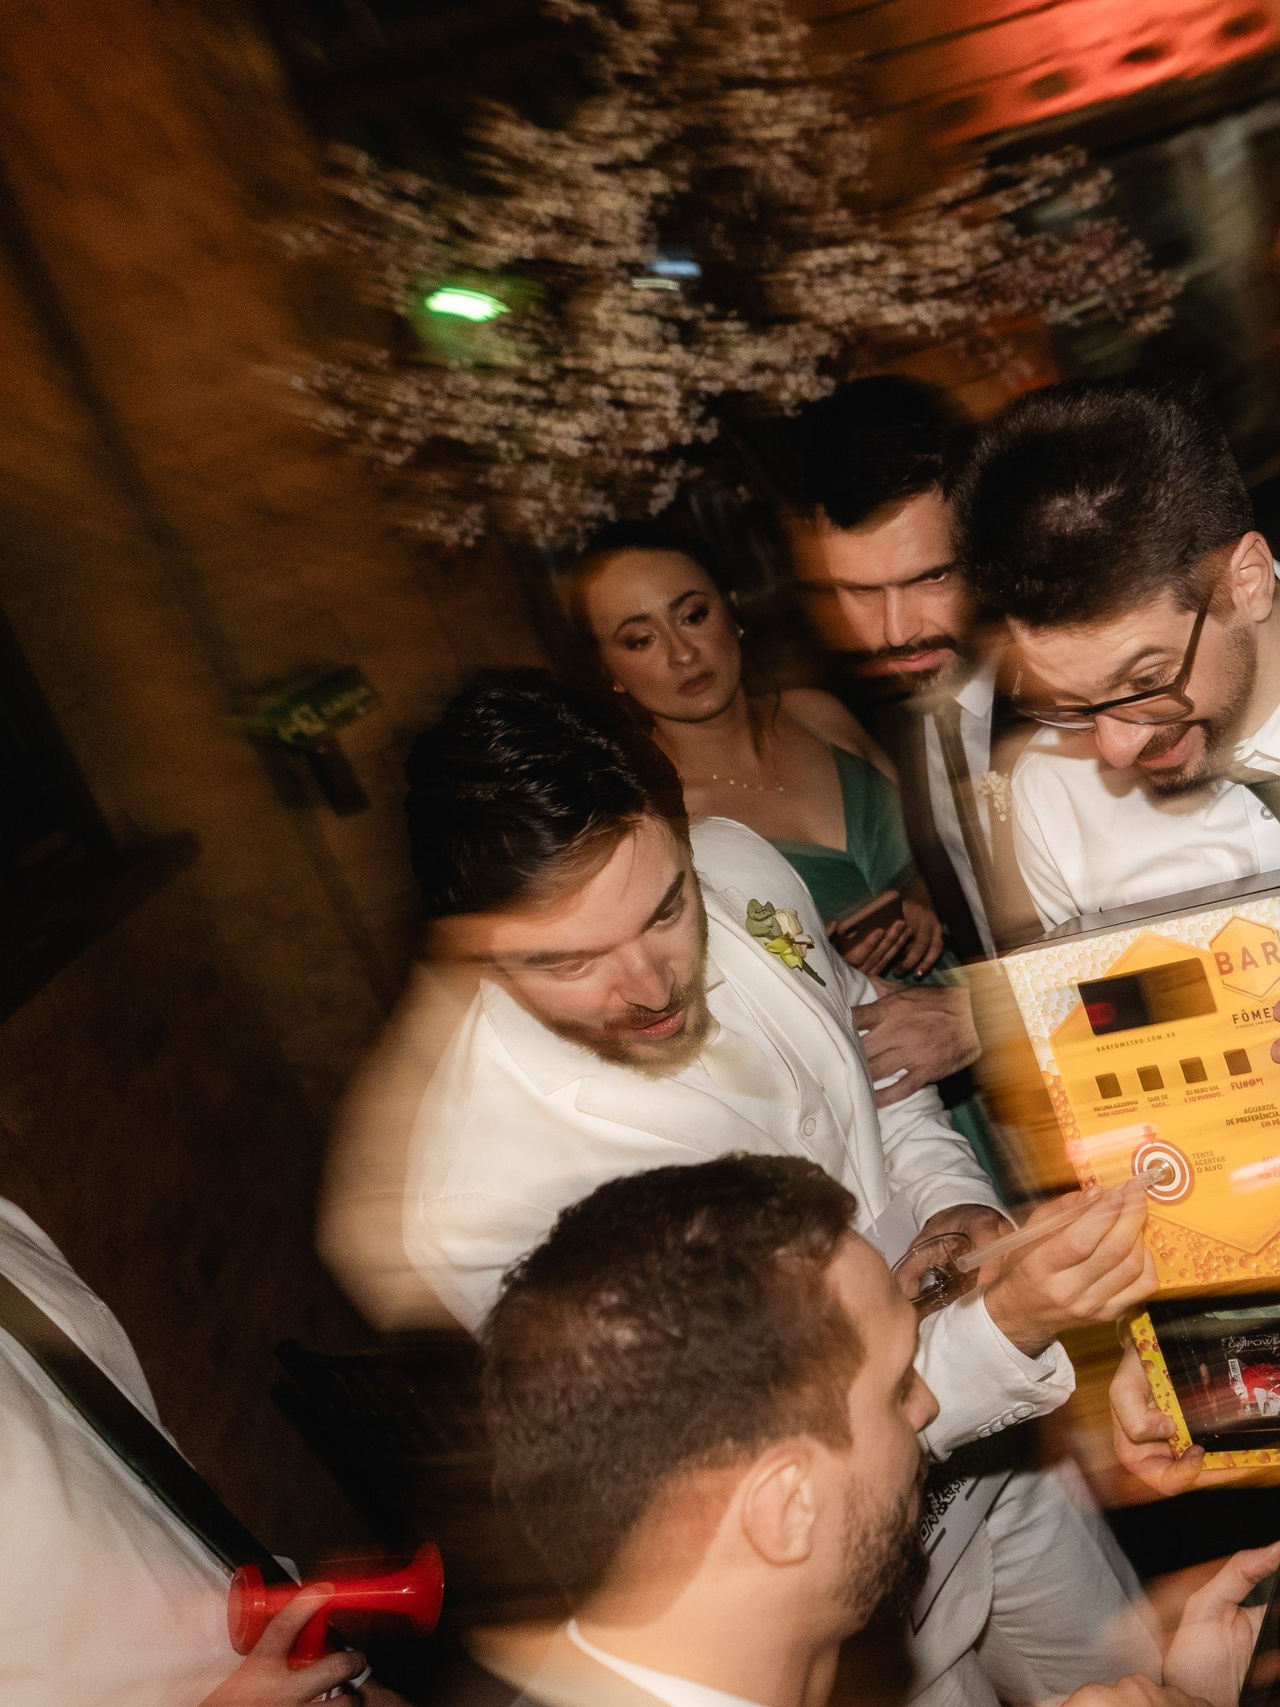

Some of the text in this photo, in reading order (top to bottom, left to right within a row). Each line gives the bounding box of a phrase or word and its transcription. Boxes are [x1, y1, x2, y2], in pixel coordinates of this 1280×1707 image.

[1231, 1006, 1275, 1025] FÔME
[1096, 1032, 1176, 1052] BARFOMETRO.COM.BR
[1194, 1087, 1208, 1095] BEBO
[1147, 1095, 1161, 1103] SABE
[1243, 1103, 1278, 1115] AGUARDE,
[1225, 1111, 1280, 1126] DE PREFERÊNCIA
[1260, 1120, 1271, 1128] EM
[1191, 1150, 1215, 1160] TENTE
[1194, 1156, 1226, 1167] ACERTAR
